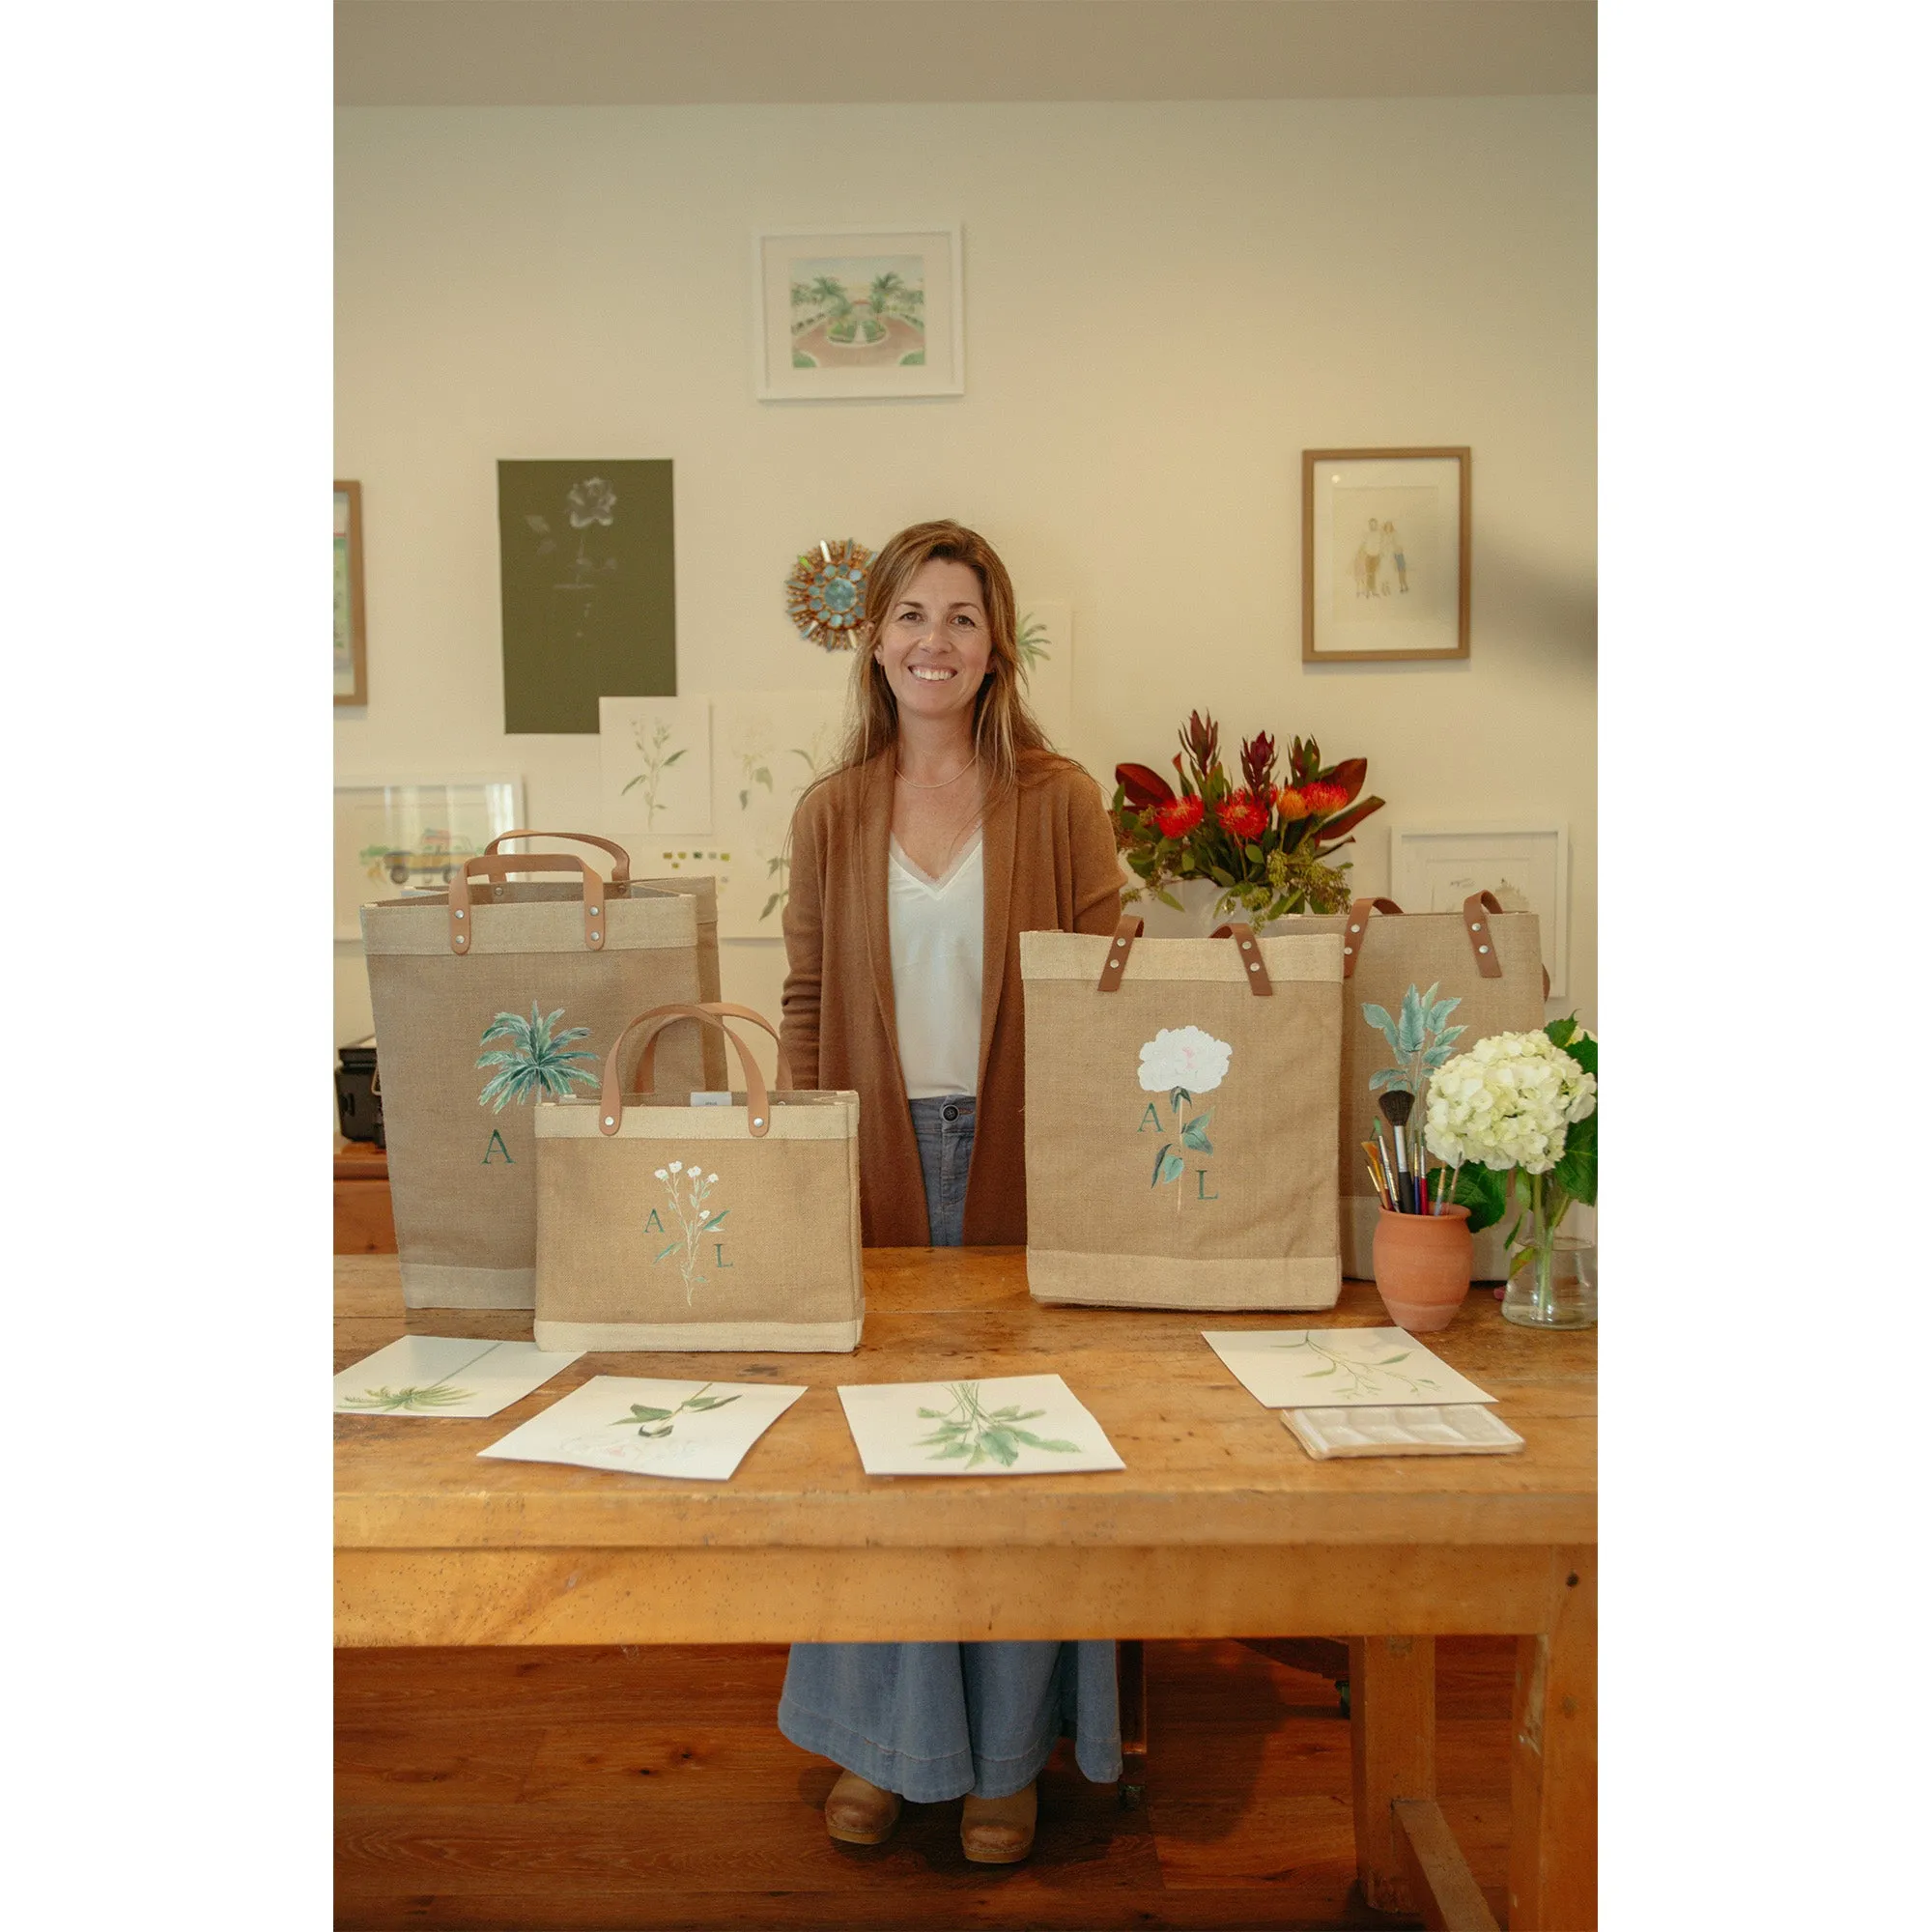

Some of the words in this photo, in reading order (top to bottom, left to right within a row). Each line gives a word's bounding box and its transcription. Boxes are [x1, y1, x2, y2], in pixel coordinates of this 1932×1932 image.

[1137, 1102, 1165, 1132] A
[480, 1129, 517, 1164] A
[1196, 1170, 1219, 1200] L
[643, 1208, 665, 1233] A
[714, 1243, 733, 1267] L
